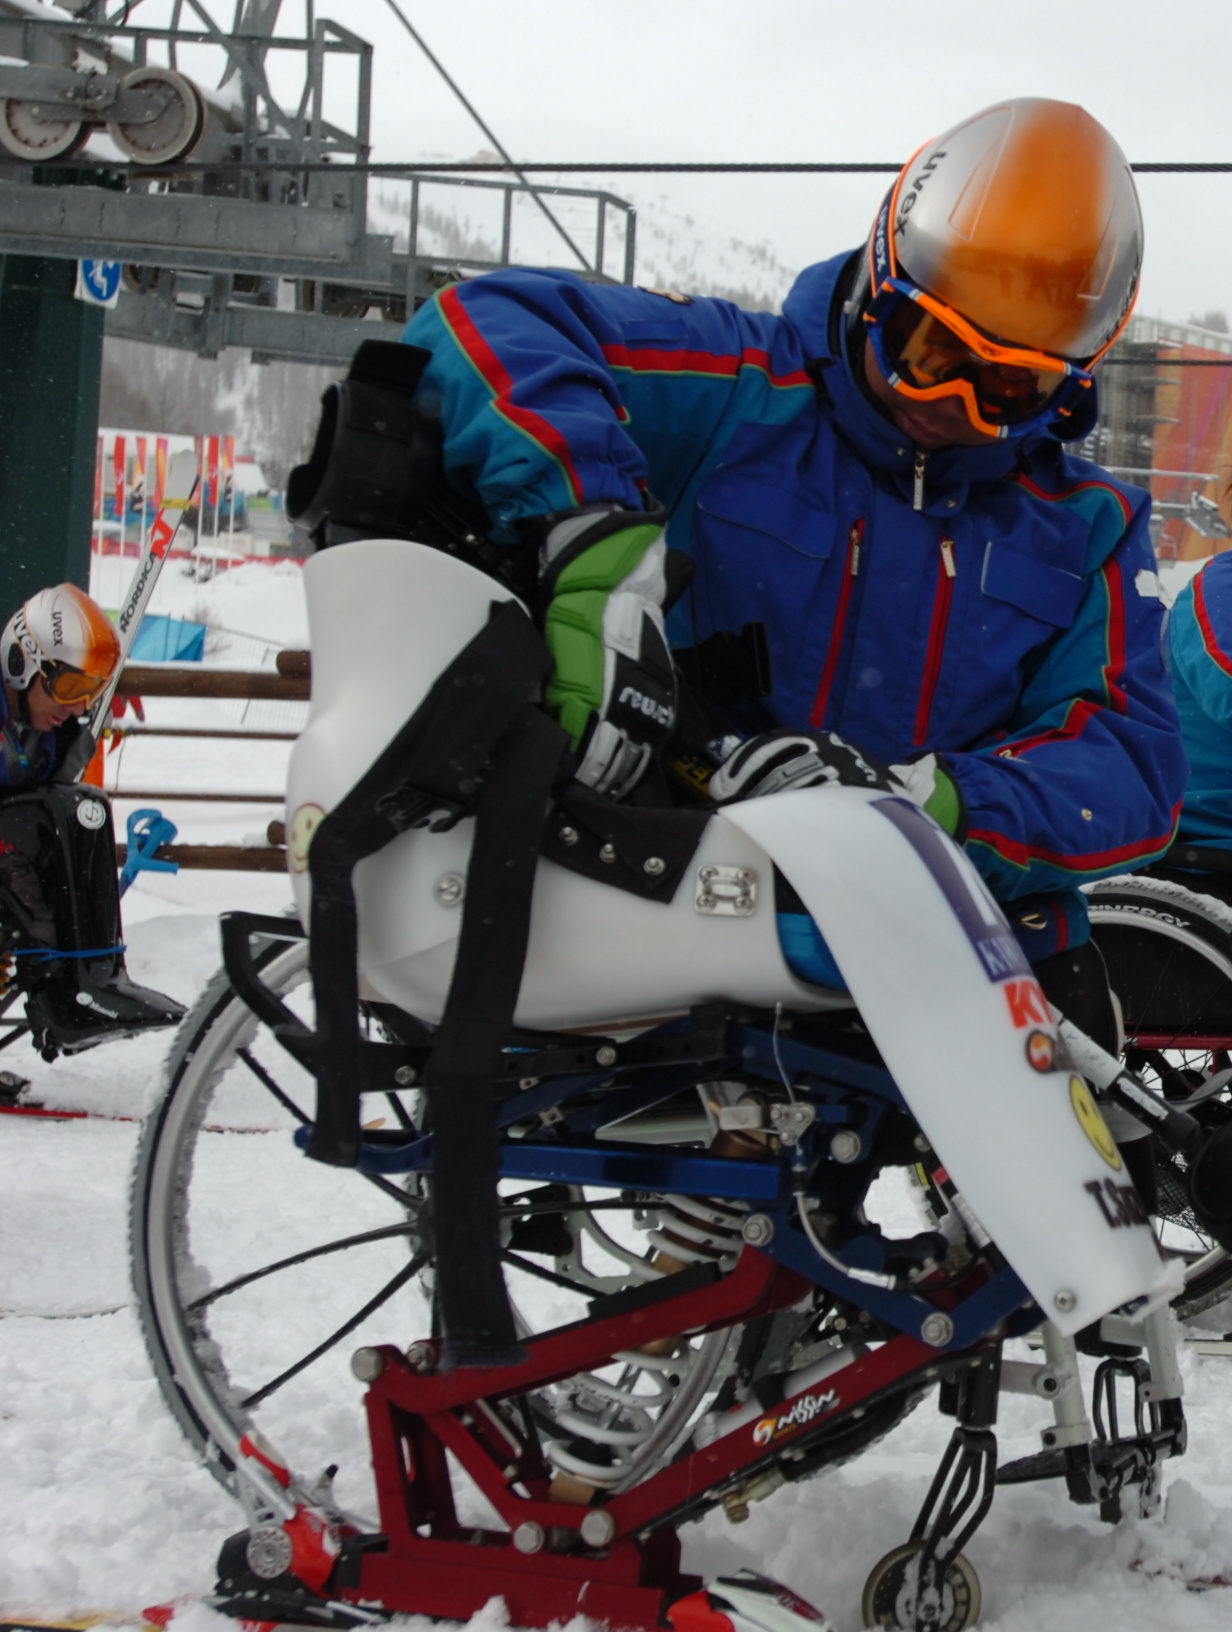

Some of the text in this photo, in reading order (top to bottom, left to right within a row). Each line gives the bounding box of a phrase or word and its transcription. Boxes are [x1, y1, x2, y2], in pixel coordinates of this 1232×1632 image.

[893, 151, 947, 237] uvex
[876, 204, 889, 273] uvex
[119, 552, 158, 633] NORDICA
[13, 611, 50, 664] uvex
[52, 611, 64, 647] uvex
